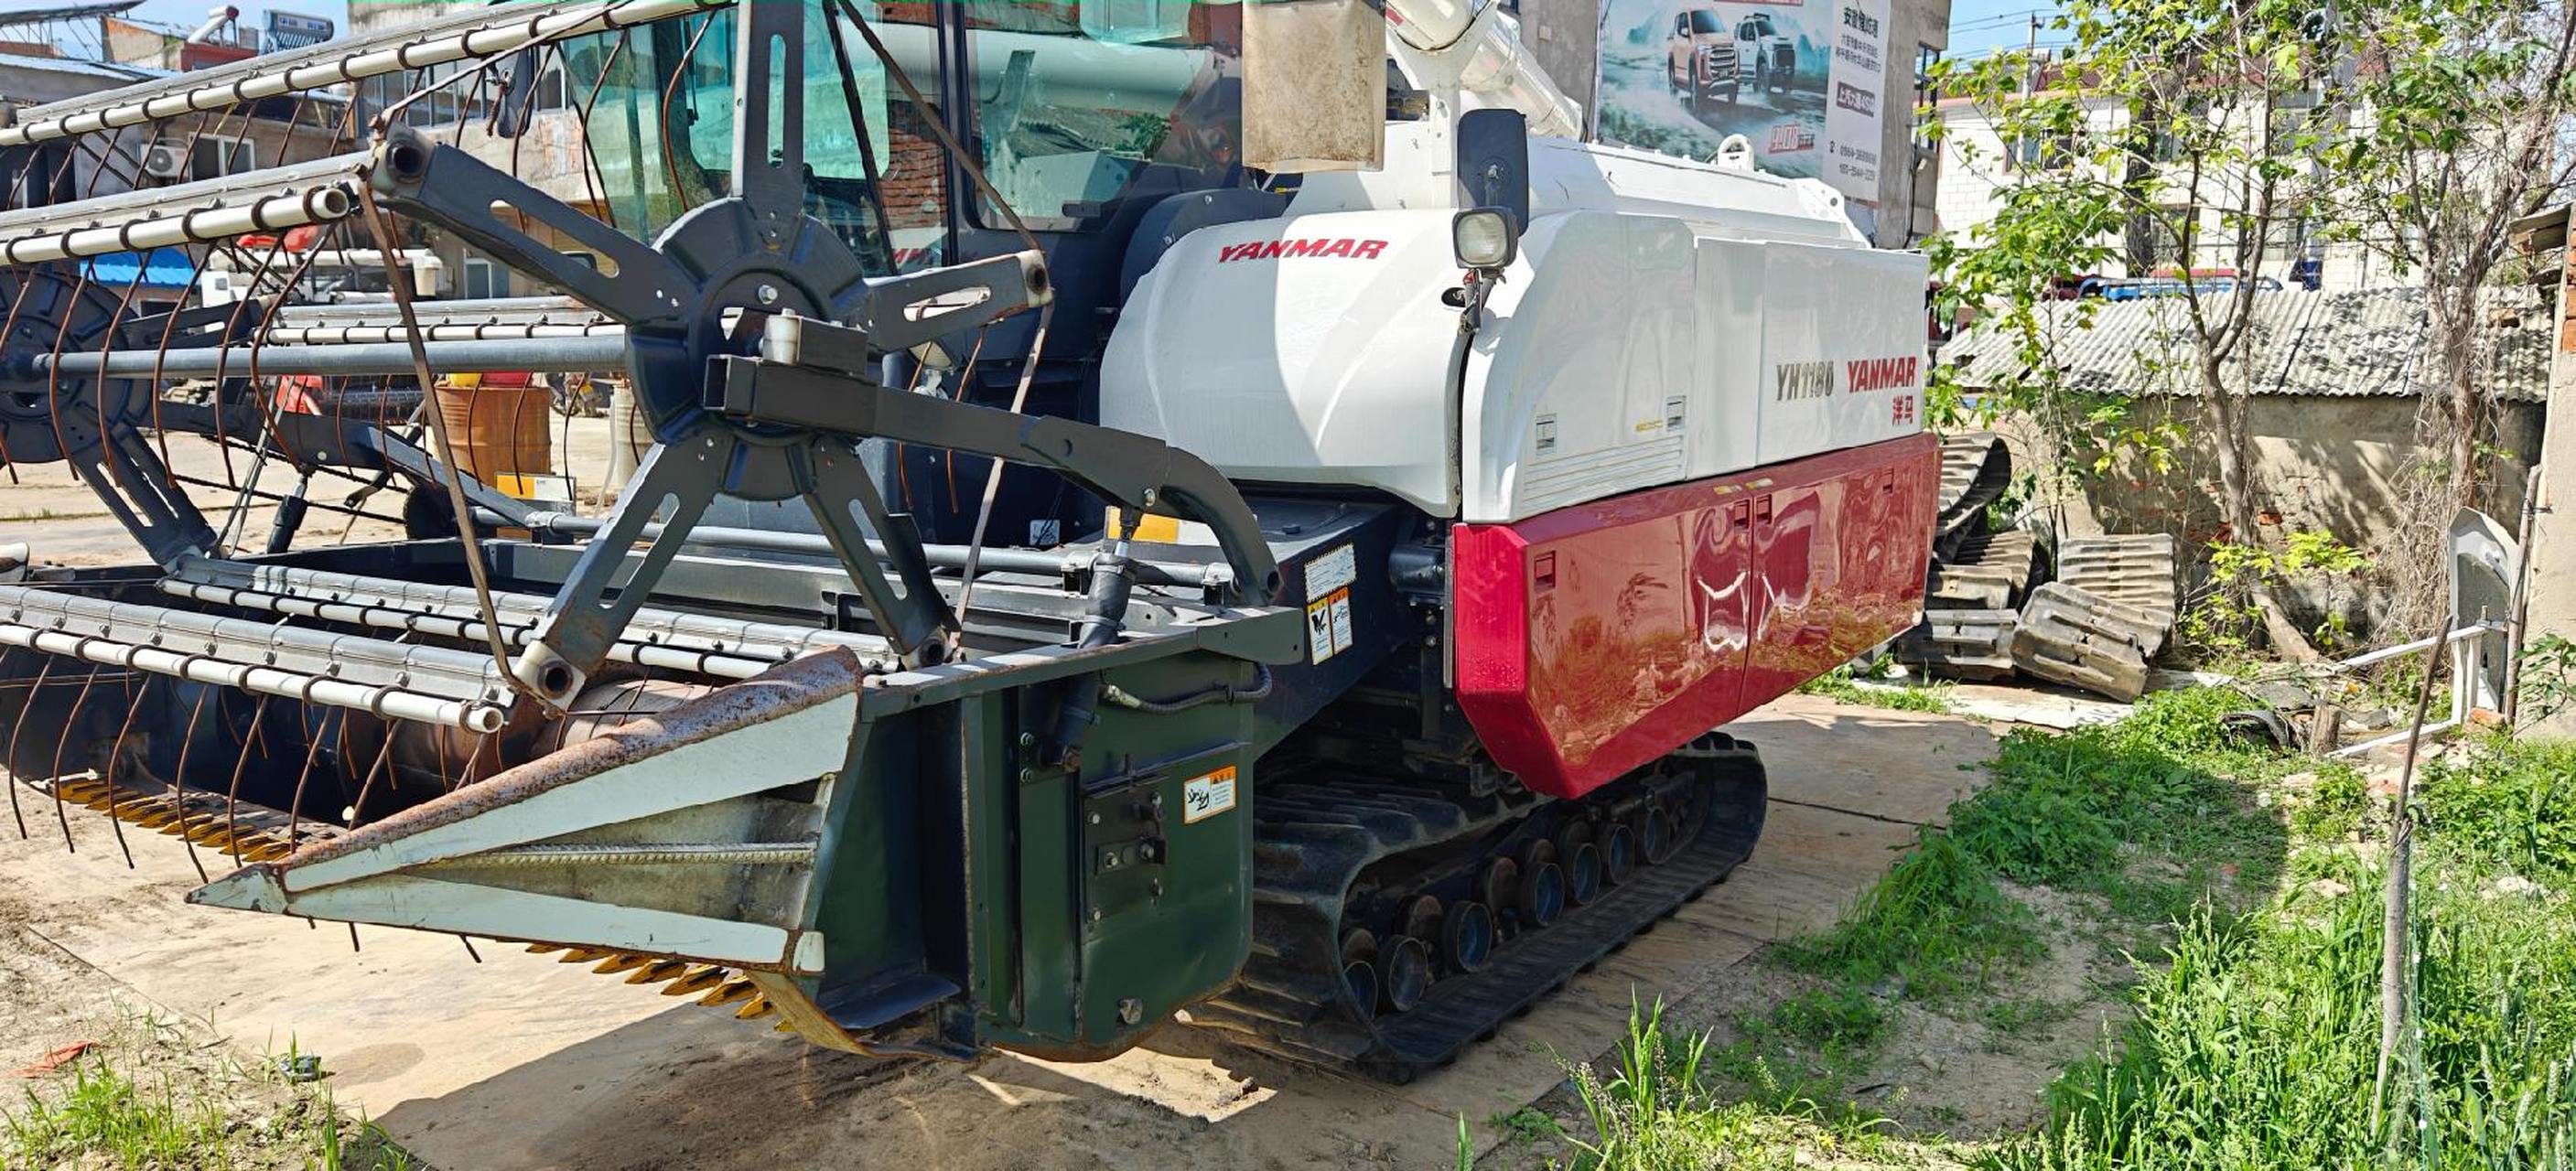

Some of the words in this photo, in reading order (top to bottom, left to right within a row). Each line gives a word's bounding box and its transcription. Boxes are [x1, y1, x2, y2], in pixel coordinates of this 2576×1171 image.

[1217, 238, 1389, 263] YANMAR
[1775, 360, 1835, 401] YH1180
[1847, 356, 1917, 393] YANMAR
[1892, 395, 1914, 426] 洋马
